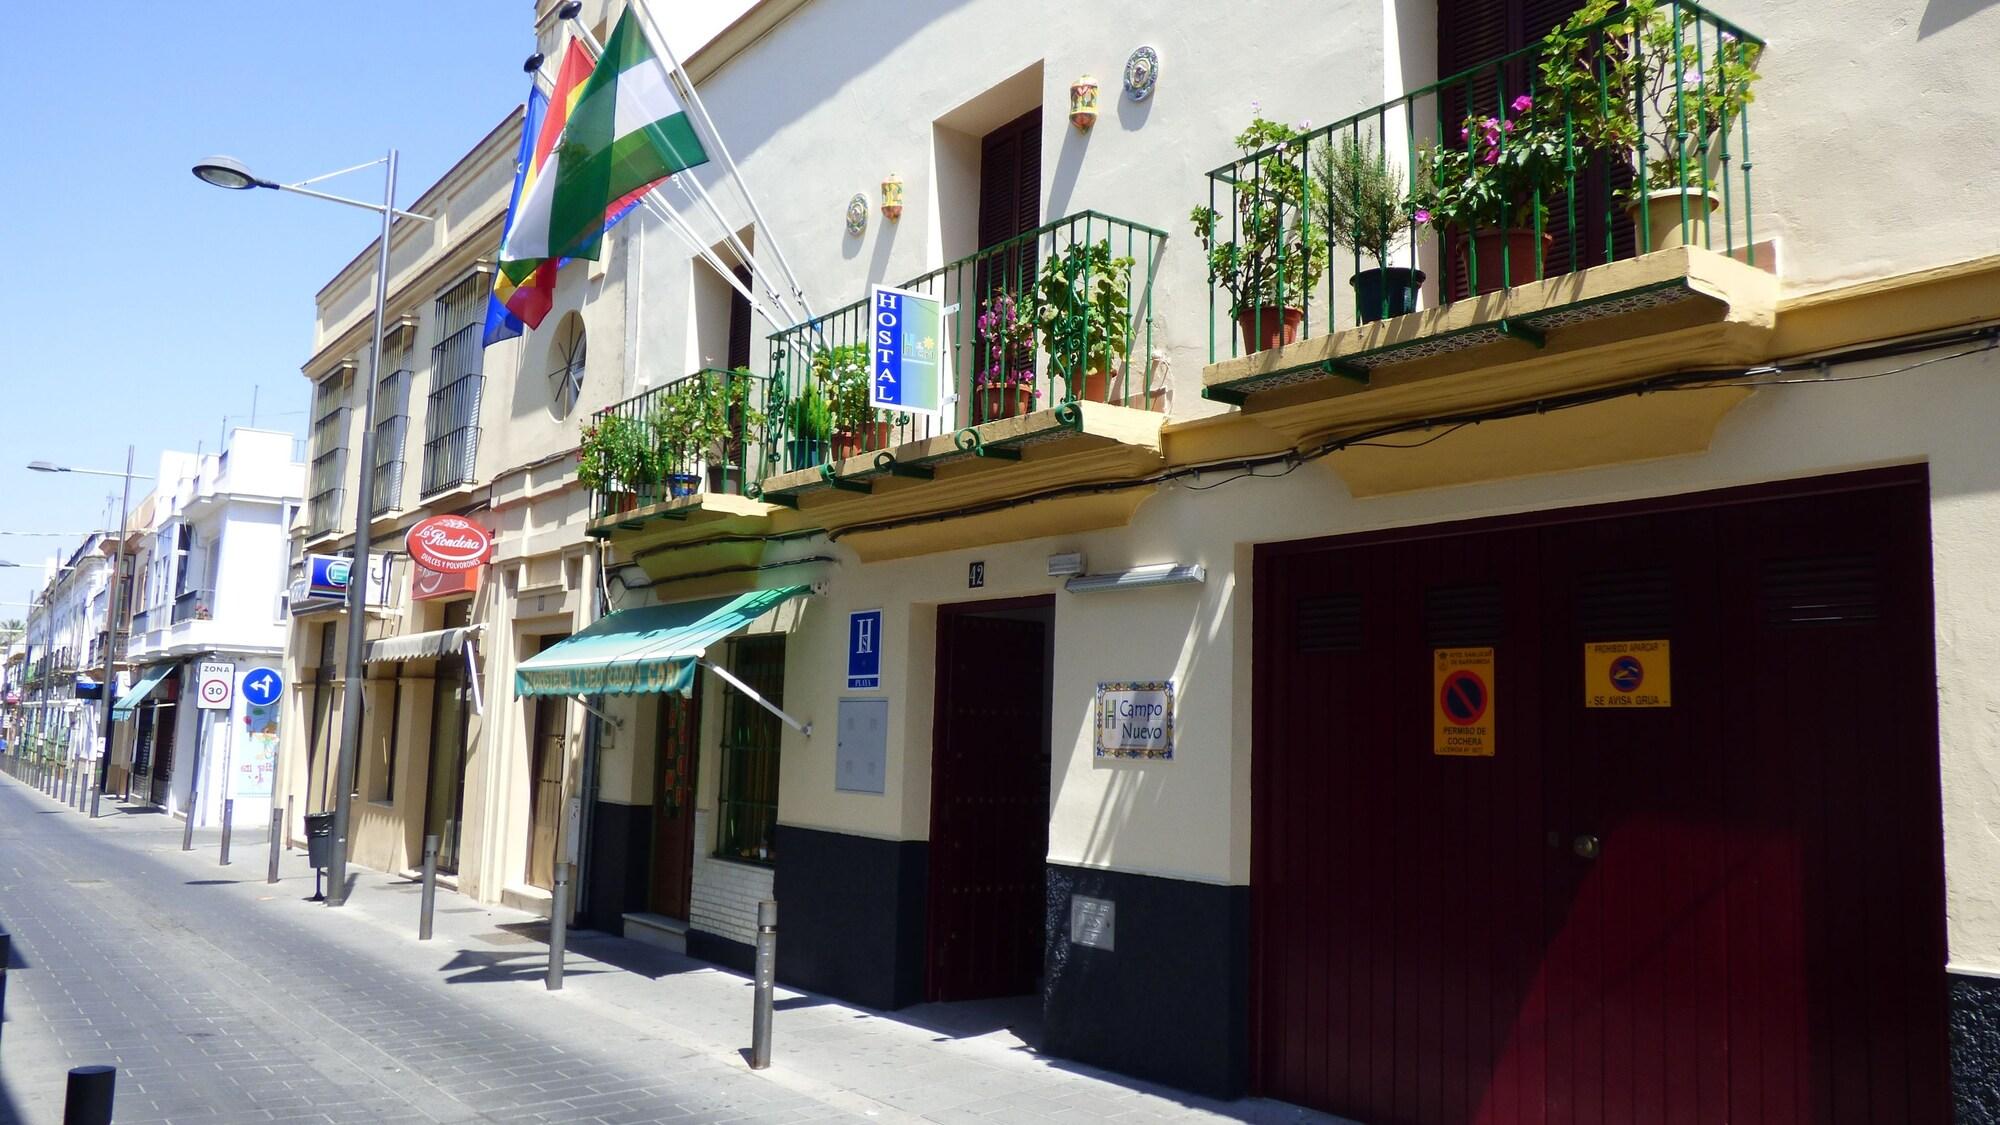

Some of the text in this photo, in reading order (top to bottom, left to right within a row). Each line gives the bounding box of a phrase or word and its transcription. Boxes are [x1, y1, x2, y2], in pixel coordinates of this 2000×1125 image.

[877, 293, 896, 401] HOSTAL
[415, 525, 433, 538] La
[421, 552, 442, 567] DULCES
[447, 558, 481, 569] POLVORONES
[970, 565, 983, 585] 42
[204, 665, 230, 673] ZONA
[208, 687, 223, 695] 30
[1594, 695, 1659, 706] SE AVISA GRUA
[1120, 700, 1162, 721] Campo
[1122, 723, 1162, 739] Nuevo
[1443, 726, 1487, 736] PERMISO DE
[1447, 737, 1482, 746] COCHERA
